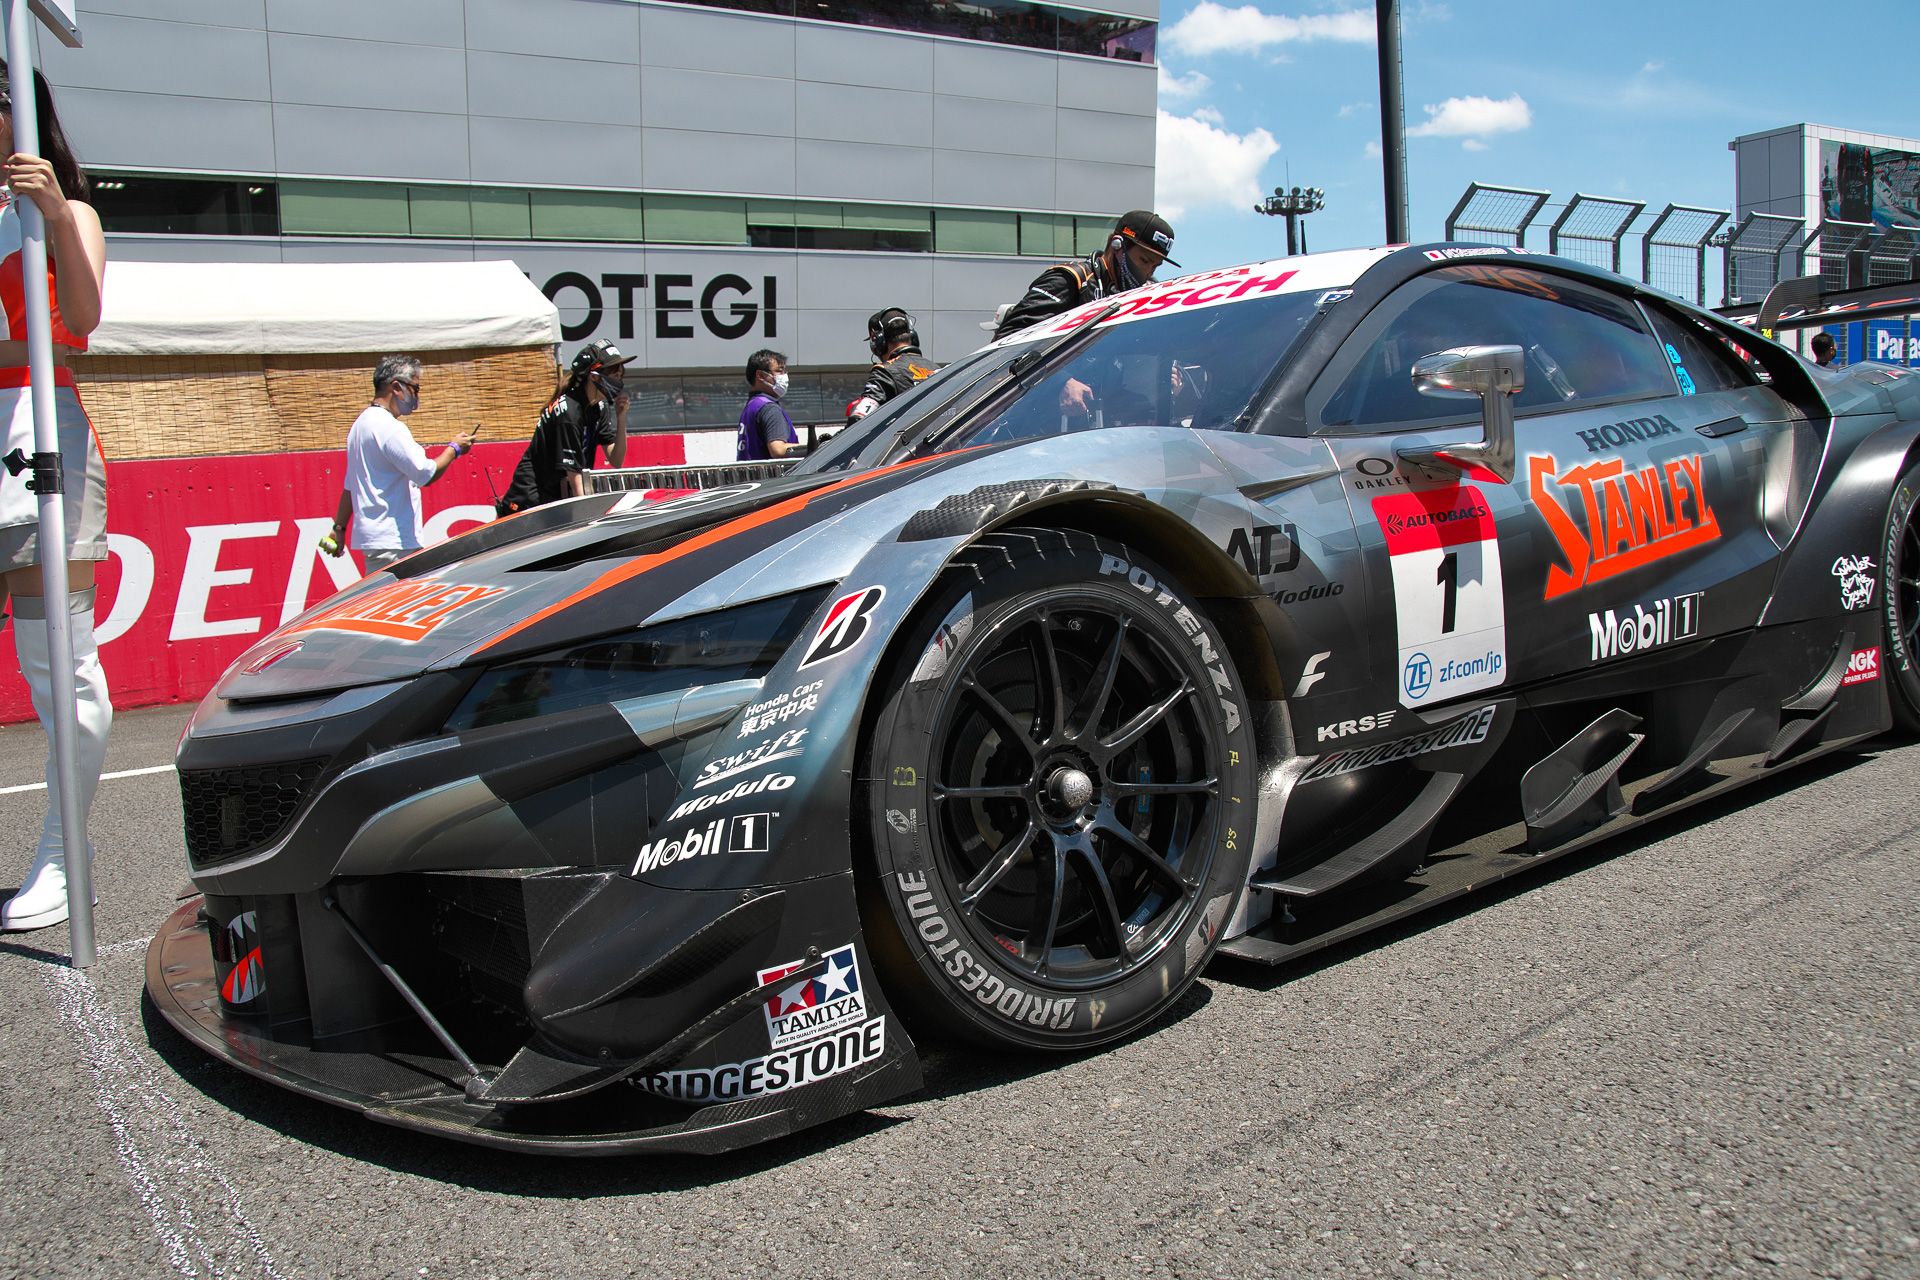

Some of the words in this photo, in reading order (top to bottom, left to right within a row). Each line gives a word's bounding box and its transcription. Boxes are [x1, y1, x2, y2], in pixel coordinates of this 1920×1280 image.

[523, 271, 777, 342] OTEGI
[1051, 270, 1300, 332] BOSCH
[1576, 414, 1681, 452] HONDA
[1355, 476, 1412, 490] OAKLEY
[1406, 506, 1487, 528] AUTOBACS
[1529, 454, 1722, 600] STANLEY
[1437, 552, 1458, 634] 1
[1886, 512, 1905, 659] BRIDGESTONE
[1099, 553, 1241, 734] POTENZA
[1589, 598, 1671, 661] Mobil
[1440, 651, 1502, 683] zf.com/jp
[1844, 674, 1861, 684] SPARK
[1862, 671, 1877, 680] PLUGS
[1845, 649, 1877, 674] NGK
[737, 694, 818, 739] 東京中央
[745, 694, 789, 718] Honda
[793, 680, 823, 698] Cars
[1299, 706, 1496, 783] BRIDGESTONE
[1317, 715, 1377, 742] KRS
[696, 728, 809, 782] Swift
[667, 772, 797, 822] Modulo
[631, 818, 726, 876] Mobil
[898, 870, 1077, 1029] BRIDGESTONE
[772, 996, 863, 1037] TAMIYA
[775, 1037, 789, 1045] FIRST
[796, 1029, 818, 1039] QUALITY
[817, 1022, 838, 1033] AROUND
[848, 1012, 864, 1022] WORLD
